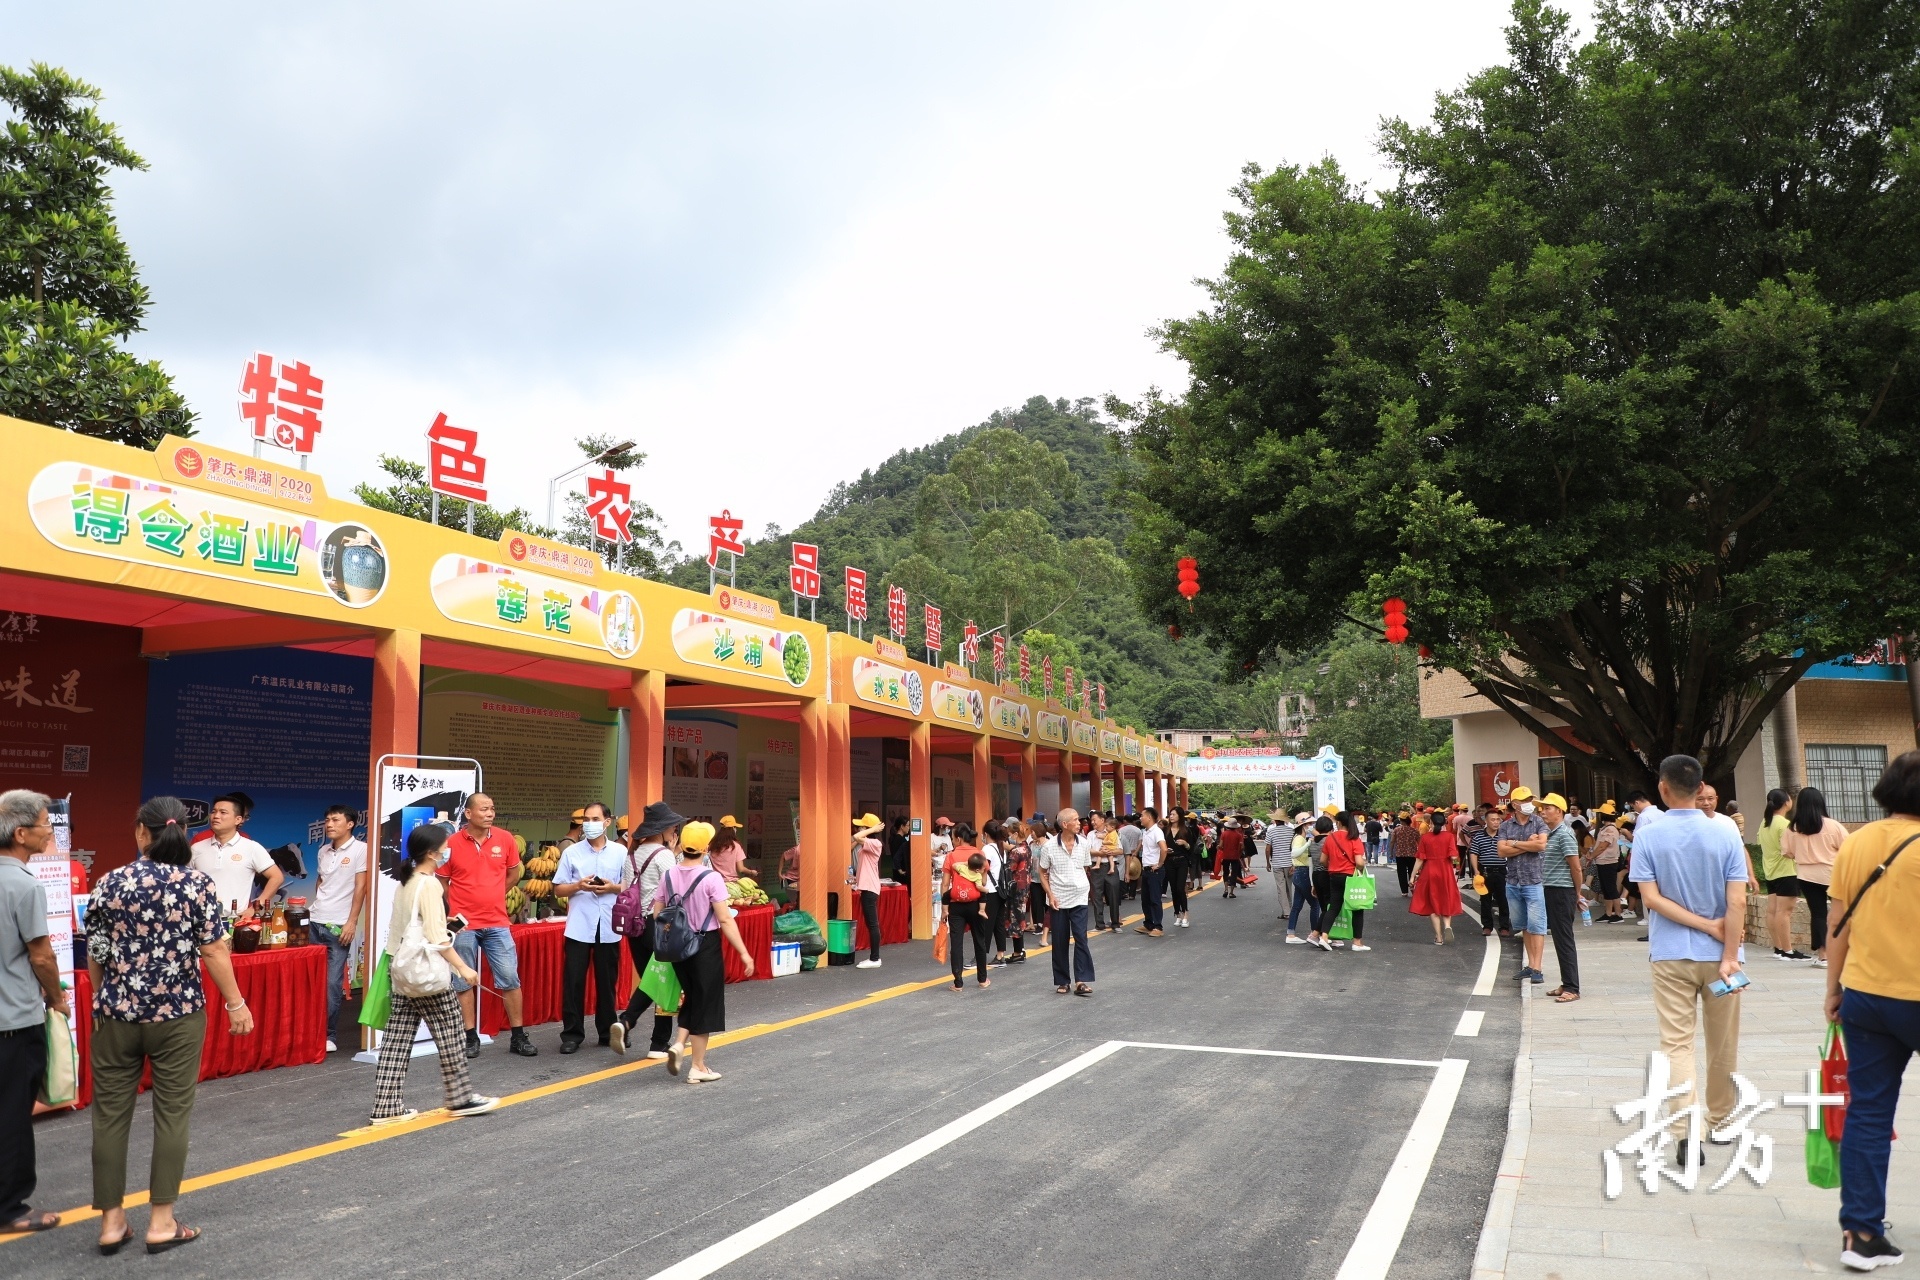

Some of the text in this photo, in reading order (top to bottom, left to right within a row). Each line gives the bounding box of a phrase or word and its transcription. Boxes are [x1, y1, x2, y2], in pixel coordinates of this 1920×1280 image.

[207, 456, 312, 494] 肇庆·鼎湖 2020
[279, 489, 296, 499] 9/22
[70, 481, 300, 575] 得令酒业
[573, 556, 594, 569] 2020
[496, 577, 572, 634] 莲花
[713, 627, 763, 669] 沙浦
[0, 665, 95, 713] 味道
[251, 674, 355, 695] 广东温氏乳业有限公司简介
[26, 721, 39, 729] TO
[43, 722, 68, 731] TASTE
[667, 724, 703, 745] 特色产品
[767, 738, 794, 755] 特色产品
[1217, 747, 1282, 757] 中国农民丰收节
[392, 774, 420, 792] 得令
